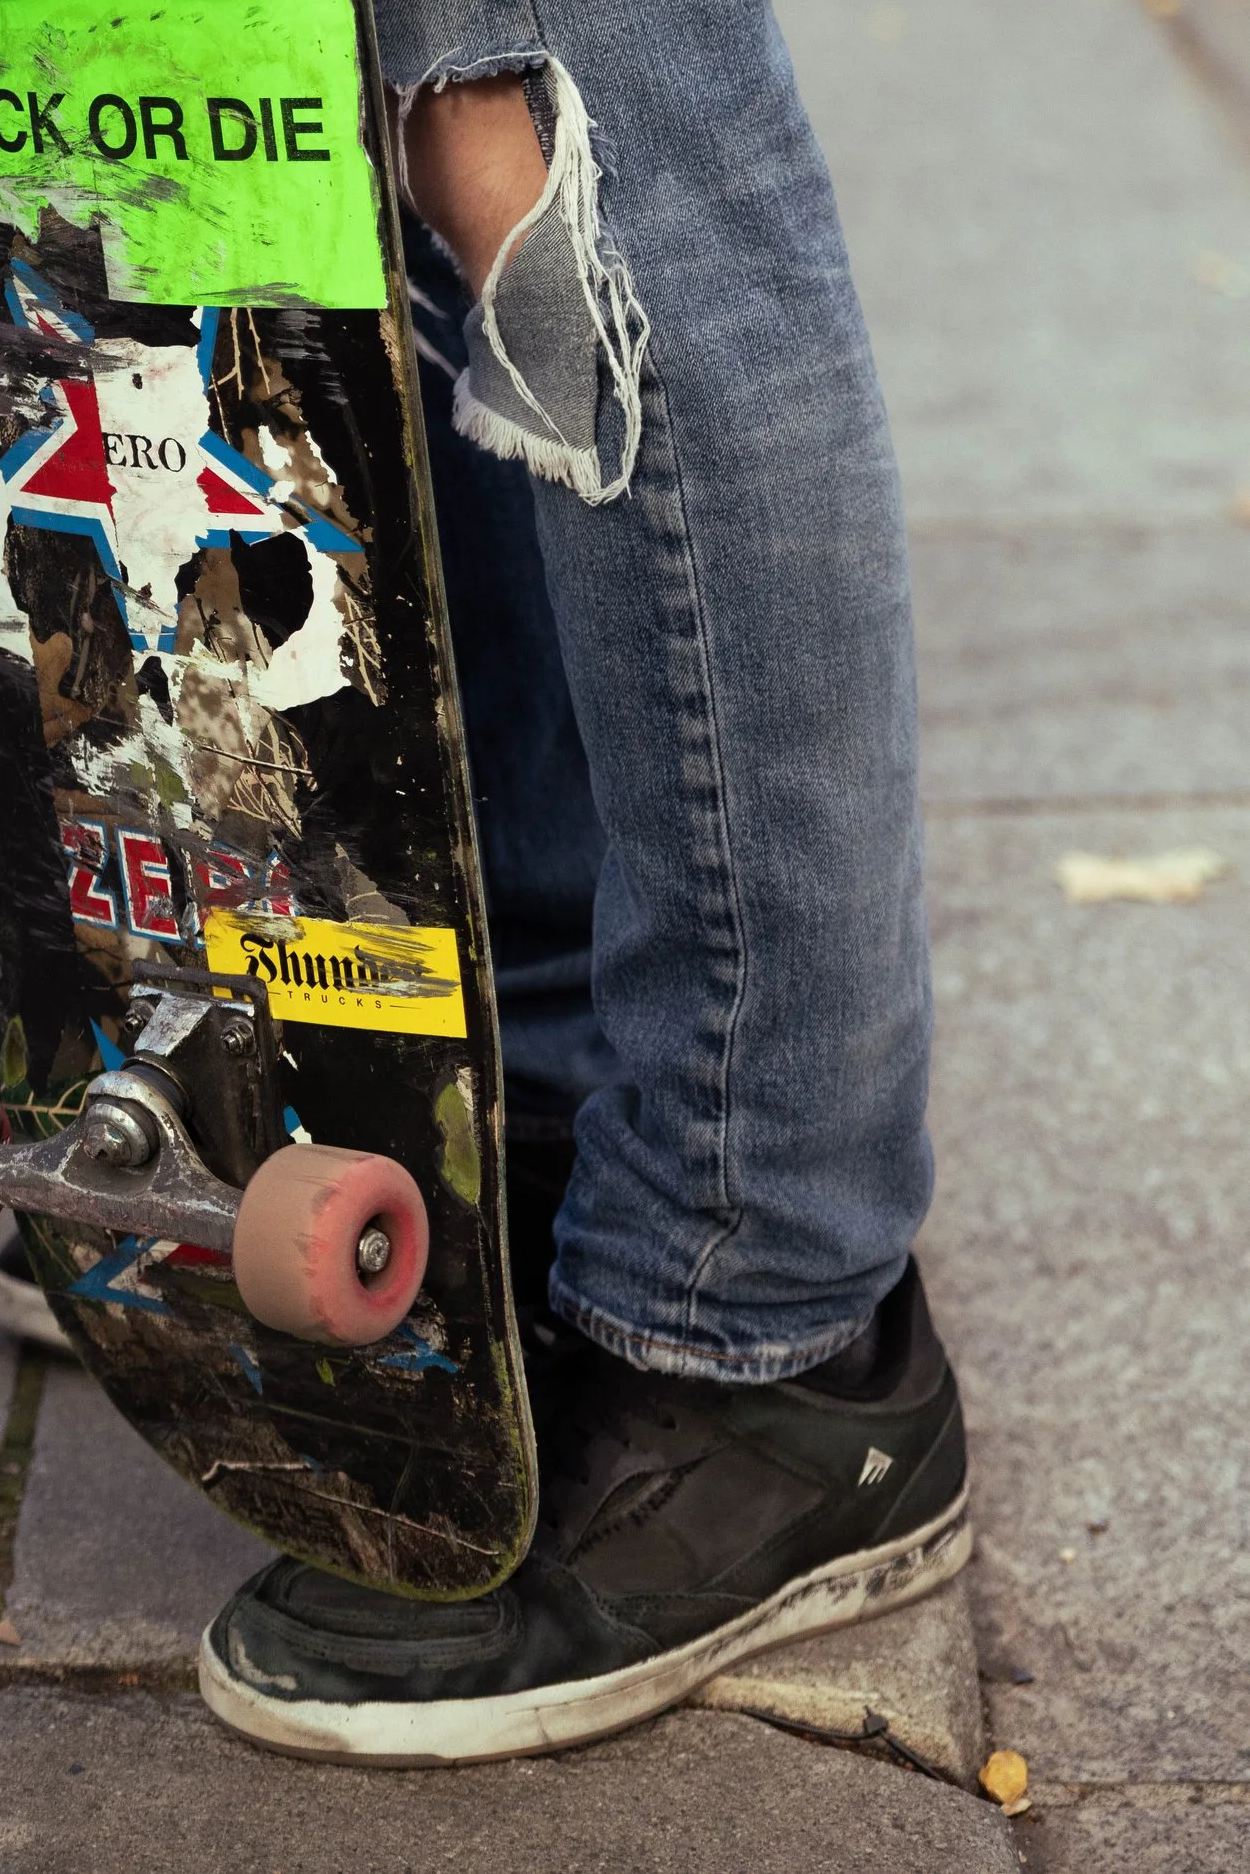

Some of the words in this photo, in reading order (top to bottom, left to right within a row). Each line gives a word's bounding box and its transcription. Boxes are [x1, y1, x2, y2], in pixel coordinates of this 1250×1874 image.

[88, 93, 190, 161] OR
[206, 97, 331, 162] DIE
[287, 990, 383, 1009] TRUCKS
